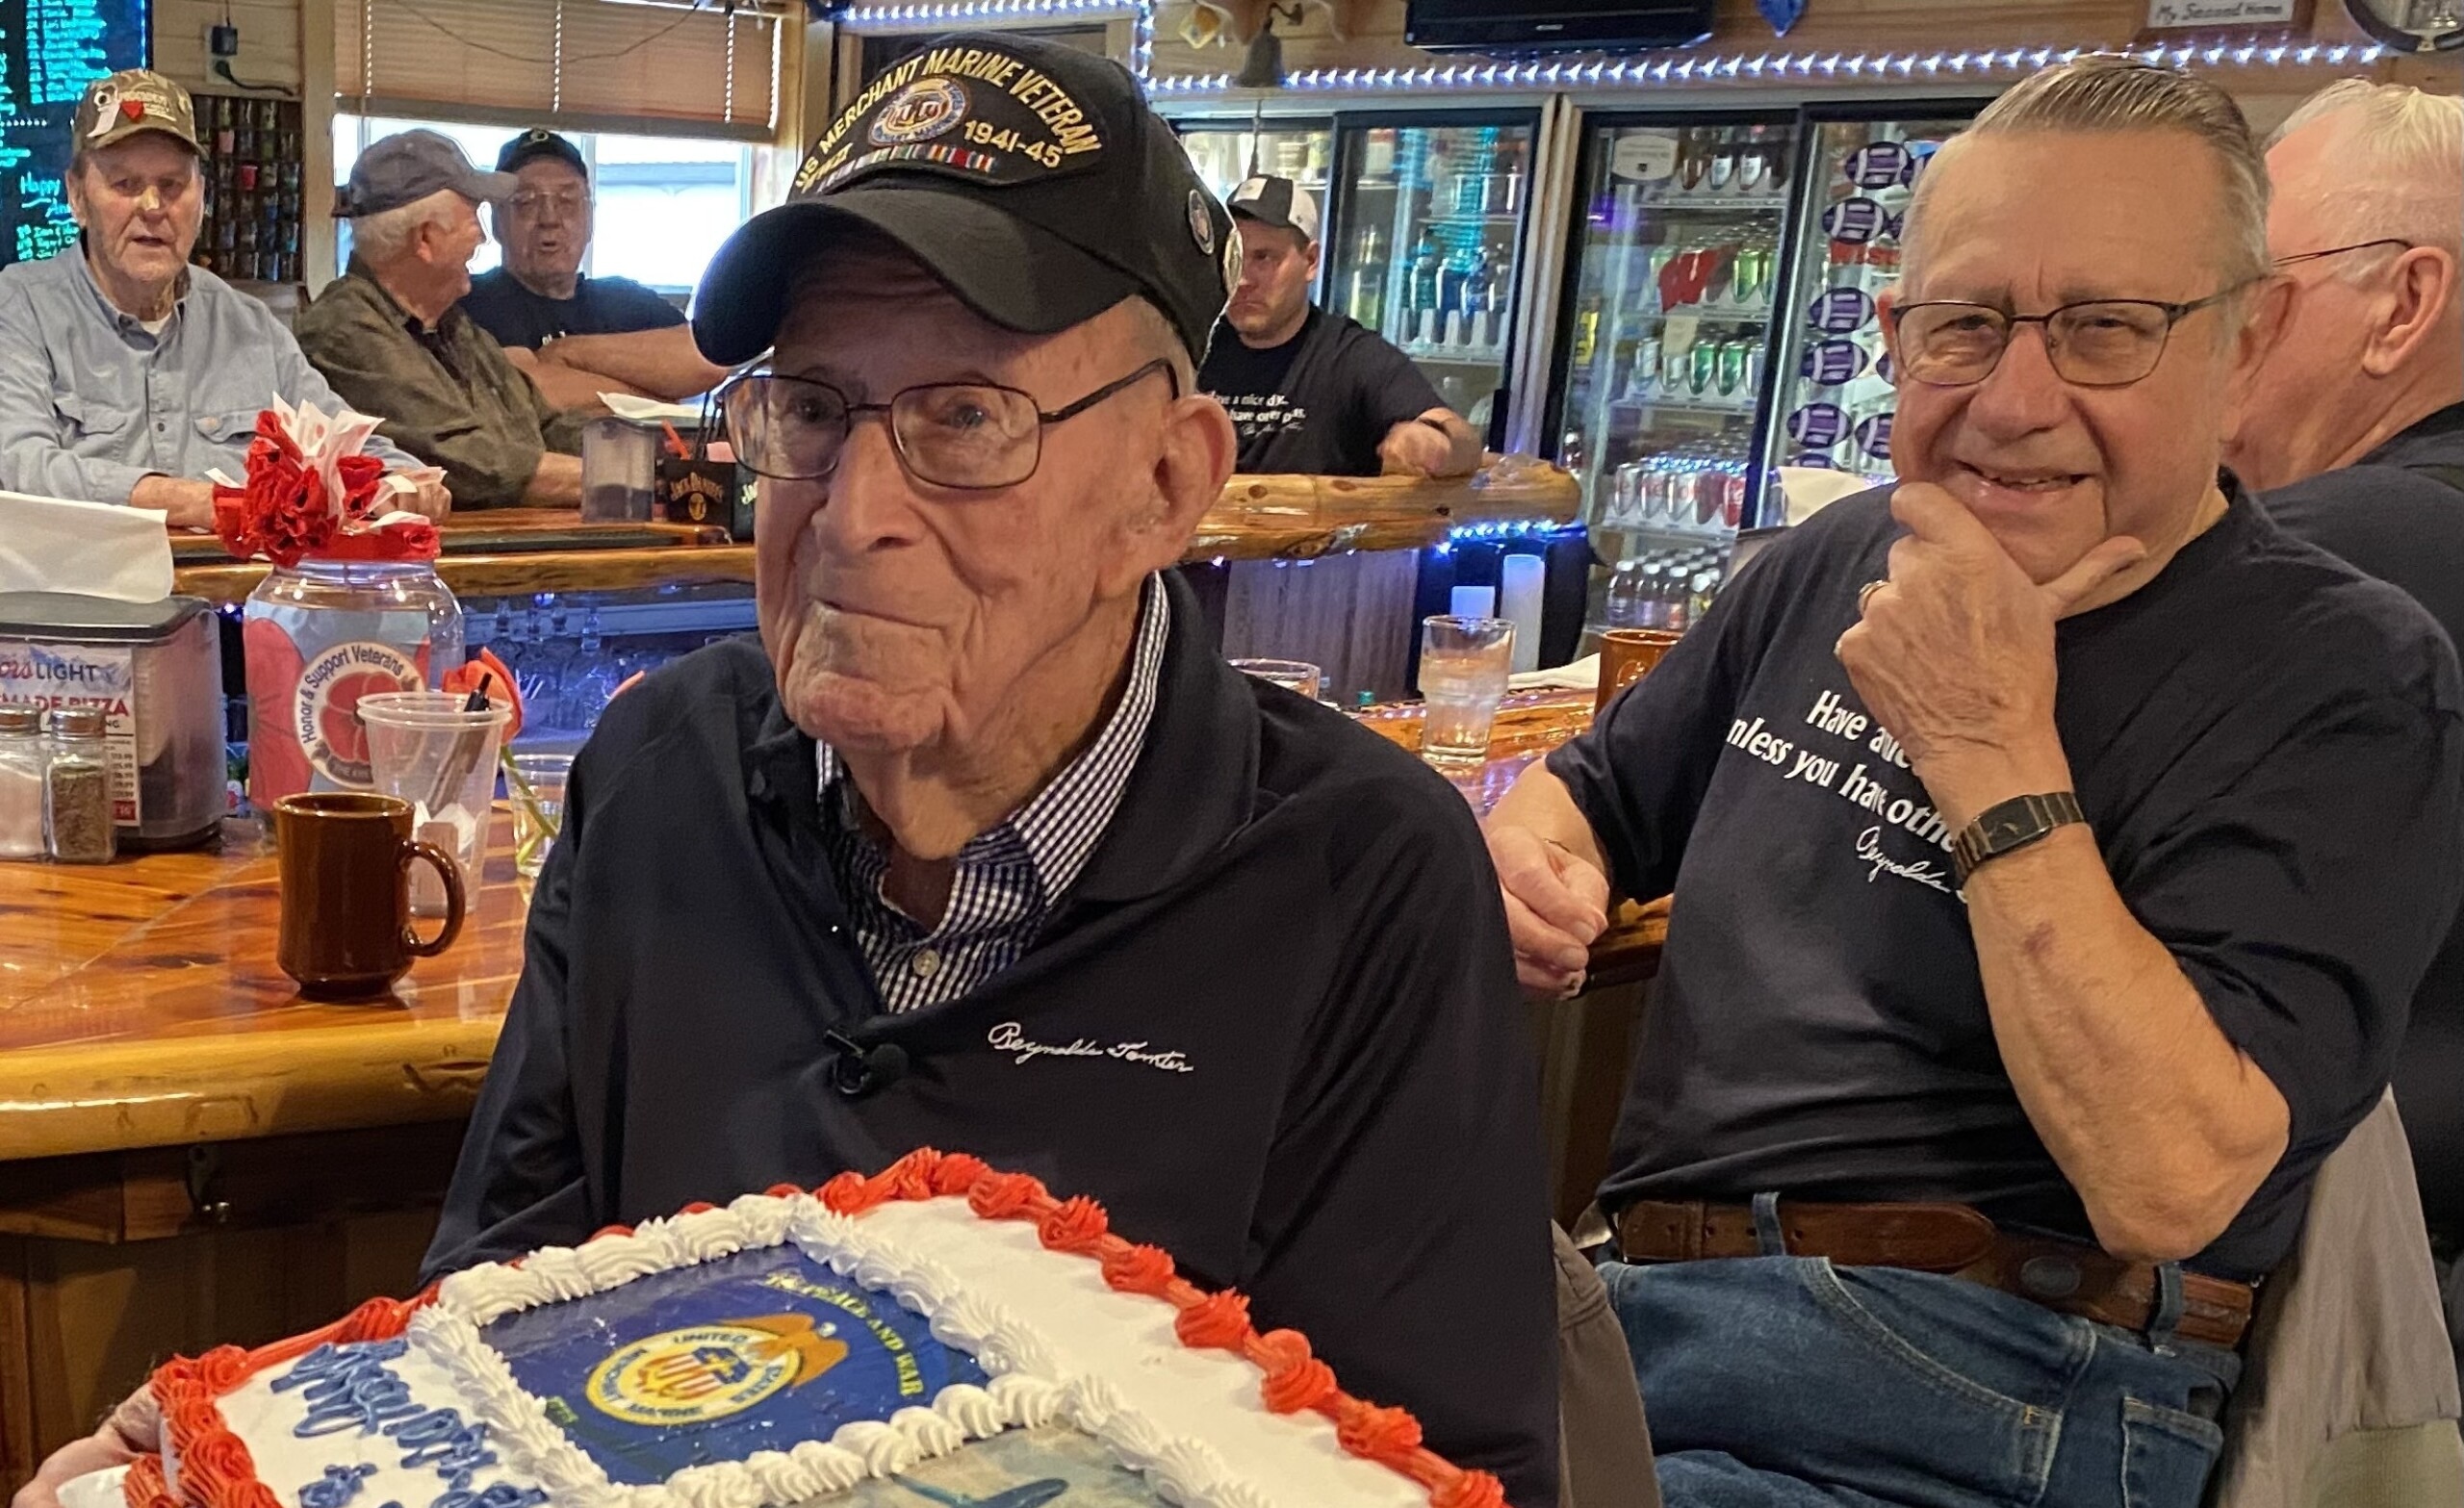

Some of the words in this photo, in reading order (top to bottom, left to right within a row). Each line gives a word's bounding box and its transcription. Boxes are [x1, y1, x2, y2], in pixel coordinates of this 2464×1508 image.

[795, 156, 819, 188] US
[819, 55, 925, 154] MERCHANT
[921, 48, 1024, 88] MARINE
[1009, 68, 1102, 155] VETERAN
[963, 119, 1064, 168] 1941-45
[37, 663, 97, 682] LIGHT
[304, 648, 350, 689] Support
[351, 645, 405, 677] Veterans
[299, 689, 316, 701] &
[1807, 689, 1868, 740] Have
[300, 700, 318, 744] Honor
[1726, 717, 1794, 765] nless
[1784, 750, 1840, 787] you
[988, 1021, 1104, 1065] Reynolds
[673, 1334, 749, 1344] UNITED
[867, 1318, 906, 1351] AND
[895, 1351, 925, 1397] WAR
